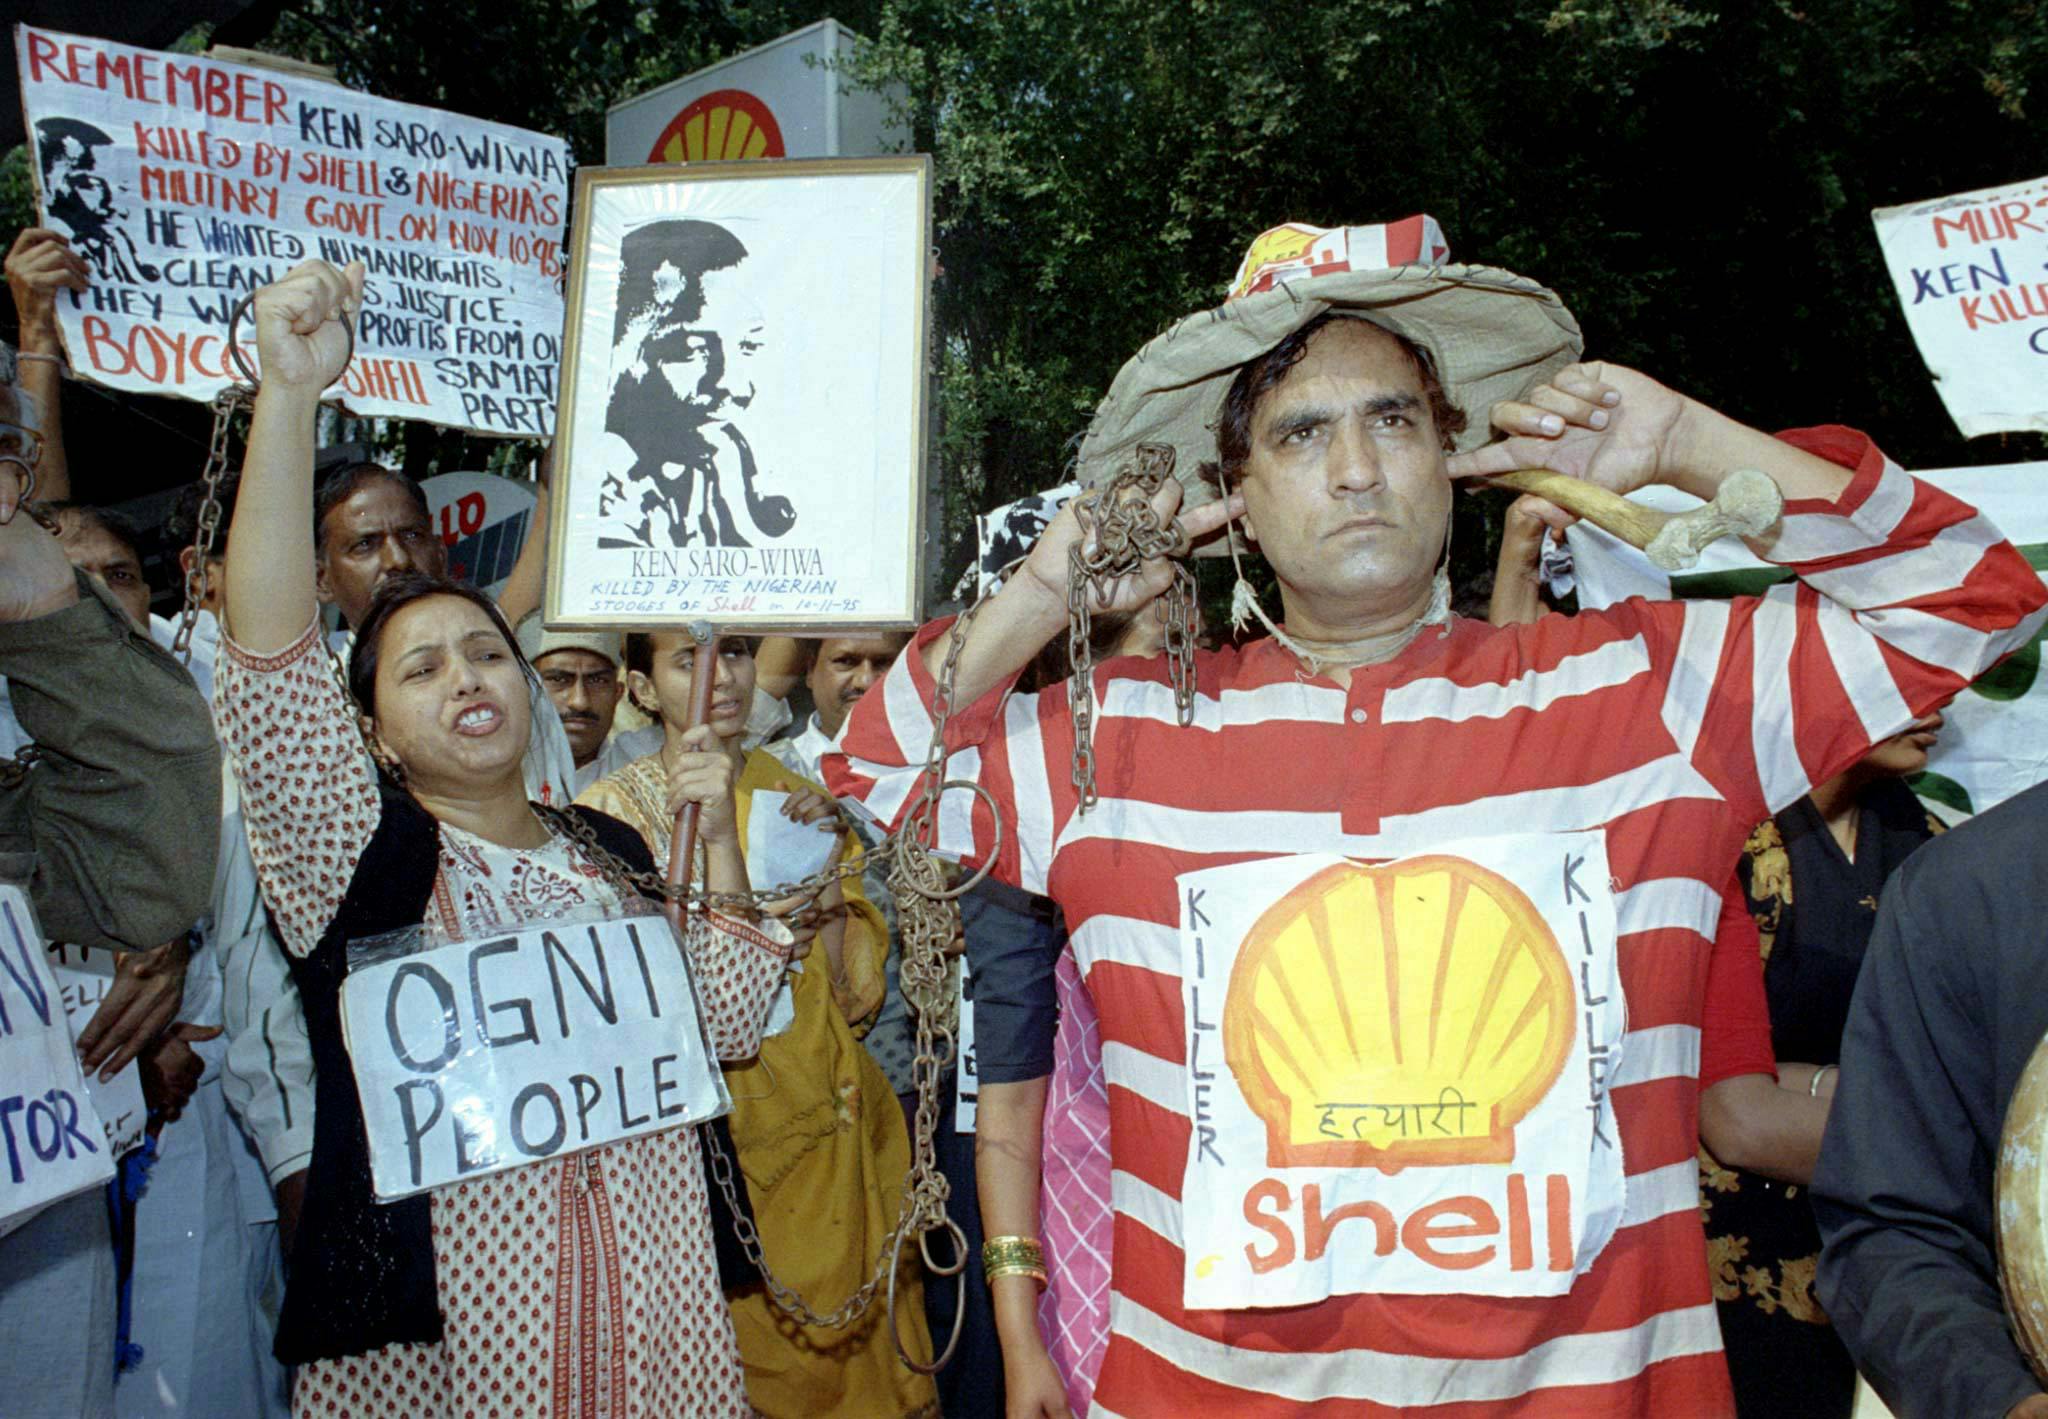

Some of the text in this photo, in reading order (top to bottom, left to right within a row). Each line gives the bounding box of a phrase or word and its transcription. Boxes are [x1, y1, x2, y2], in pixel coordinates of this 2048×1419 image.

[27, 32, 565, 184] REMEMBER KEN SARO-WIWA
[134, 121, 242, 168] KILLED
[253, 142, 291, 182] BY
[298, 152, 386, 198] SHELL
[140, 165, 278, 220] MILITARY
[400, 214, 437, 242] ON
[145, 208, 190, 248] HE
[196, 217, 306, 260] WANTED
[1933, 197, 2048, 248] MUR
[164, 258, 274, 292] CLEAN
[1911, 248, 2010, 304] KEN
[82, 315, 257, 384] BOYCO
[434, 358, 555, 402] SAMAT
[360, 310, 448, 350] PROFITS
[456, 327, 523, 360] FROM
[429, 491, 486, 547] LO
[590, 579, 837, 597] KILLED BY THE NIGERIAN
[632, 548, 824, 578] KEN SARO-WIWA
[589, 600, 665, 612] STOOGES
[706, 596, 755, 612] Shell
[384, 923, 661, 1074] OGNI
[1187, 887, 1225, 1167] KILLER
[1563, 853, 1612, 1152] KILLER
[393, 1053, 688, 1187] PEOPLE
[1243, 1173, 1575, 1275] Shell
